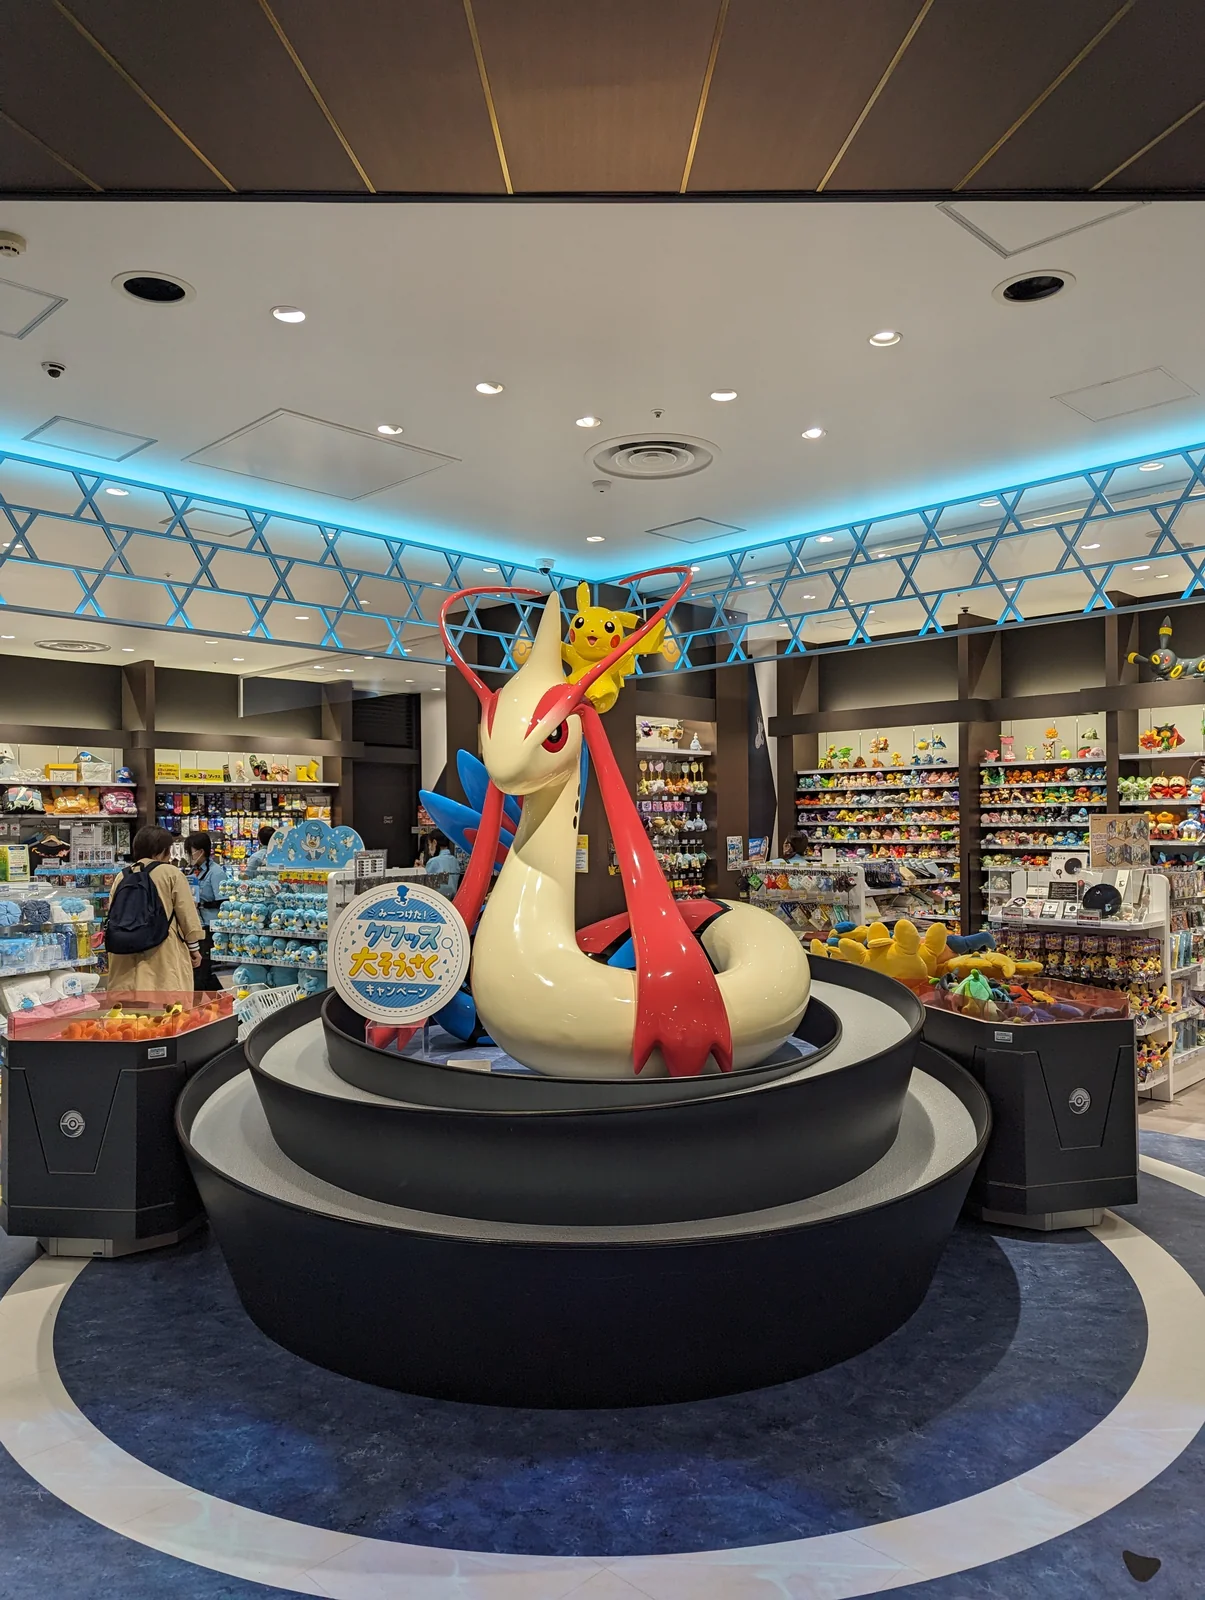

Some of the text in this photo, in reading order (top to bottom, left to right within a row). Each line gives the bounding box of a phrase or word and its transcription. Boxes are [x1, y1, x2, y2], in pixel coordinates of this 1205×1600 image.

[364, 922, 442, 950] クワッス
[348, 946, 439, 979] 大そうさく
[365, 983, 428, 998] キャンペーン
